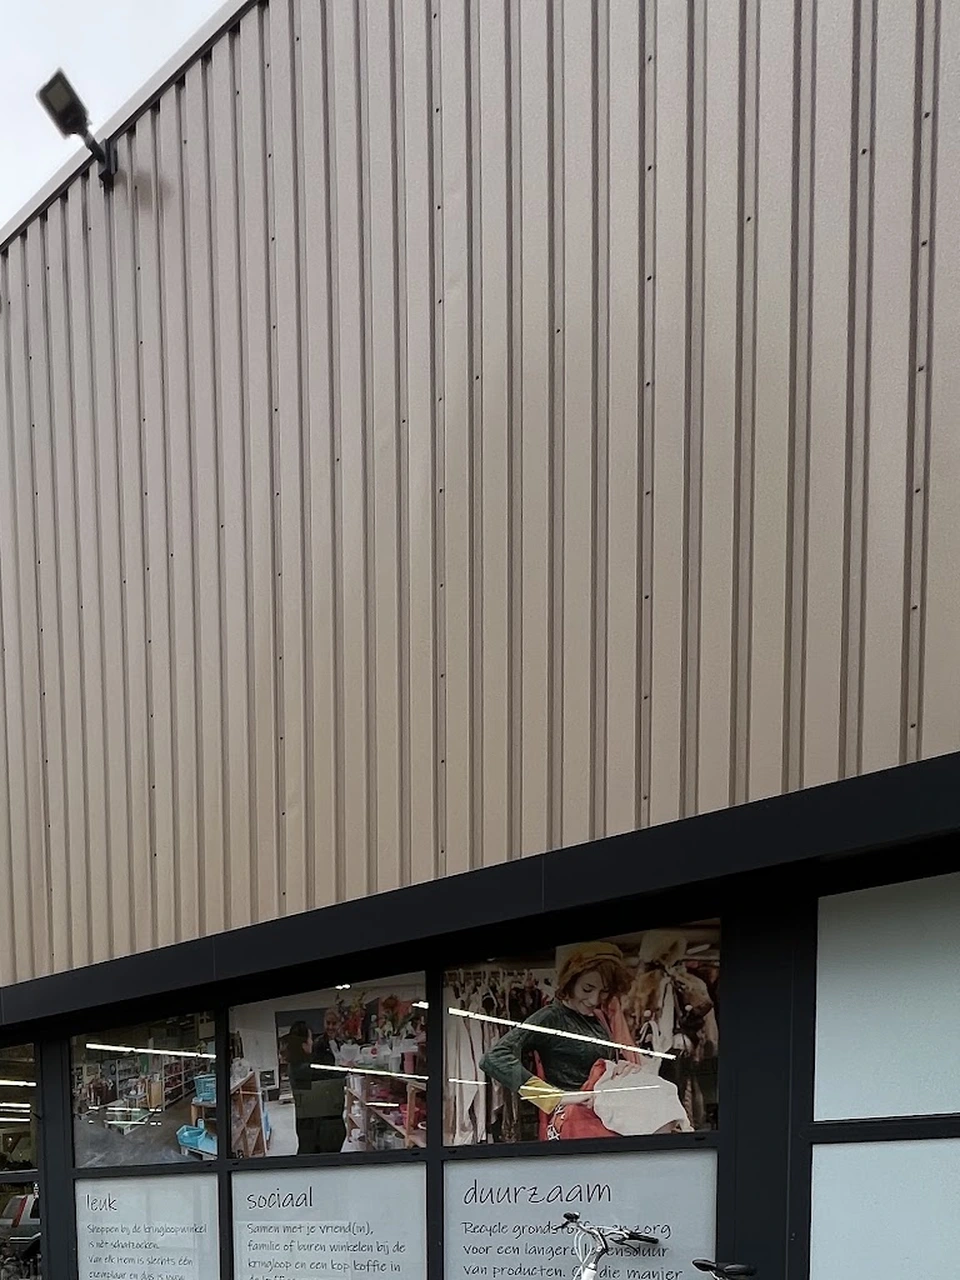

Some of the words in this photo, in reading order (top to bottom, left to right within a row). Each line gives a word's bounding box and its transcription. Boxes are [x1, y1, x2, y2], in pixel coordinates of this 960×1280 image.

[246, 1186, 314, 1210] sociaal
[463, 1179, 612, 1205] duurzaam
[86, 1193, 118, 1211] leuk
[87, 1224, 119, 1236] Shoppen
[132, 1224, 141, 1233] de
[143, 1223, 207, 1237] kringloopwinkel
[247, 1222, 280, 1235] Samen
[283, 1223, 302, 1234] met
[305, 1223, 317, 1236] je
[319, 1221, 375, 1236] vriend(in),
[460, 1221, 509, 1236] Recycle
[634, 1223, 672, 1240] zorg
[247, 1239, 281, 1252] familie
[283, 1239, 295, 1251] of
[297, 1240, 326, 1252] buren
[329, 1241, 374, 1253] winkelen
[376, 1241, 390, 1255] bij
[392, 1241, 406, 1254] de
[462, 1243, 492, 1256] voor
[496, 1244, 520, 1256] een
[524, 1242, 578, 1260] langere
[584, 1243, 670, 1257] leensduur
[88, 1255, 102, 1264] Van
[146, 1255, 176, 1266] slechts
[247, 1258, 292, 1273] kringloop
[294, 1261, 307, 1270] en
[309, 1261, 327, 1270] een
[330, 1259, 351, 1273] kop
[353, 1259, 388, 1273] koffie
[390, 1260, 401, 1272] in
[130, 1273, 139, 1280] en
[463, 1265, 488, 1276] van
[599, 1264, 621, 1279] die
[626, 1266, 684, 1280] manier
